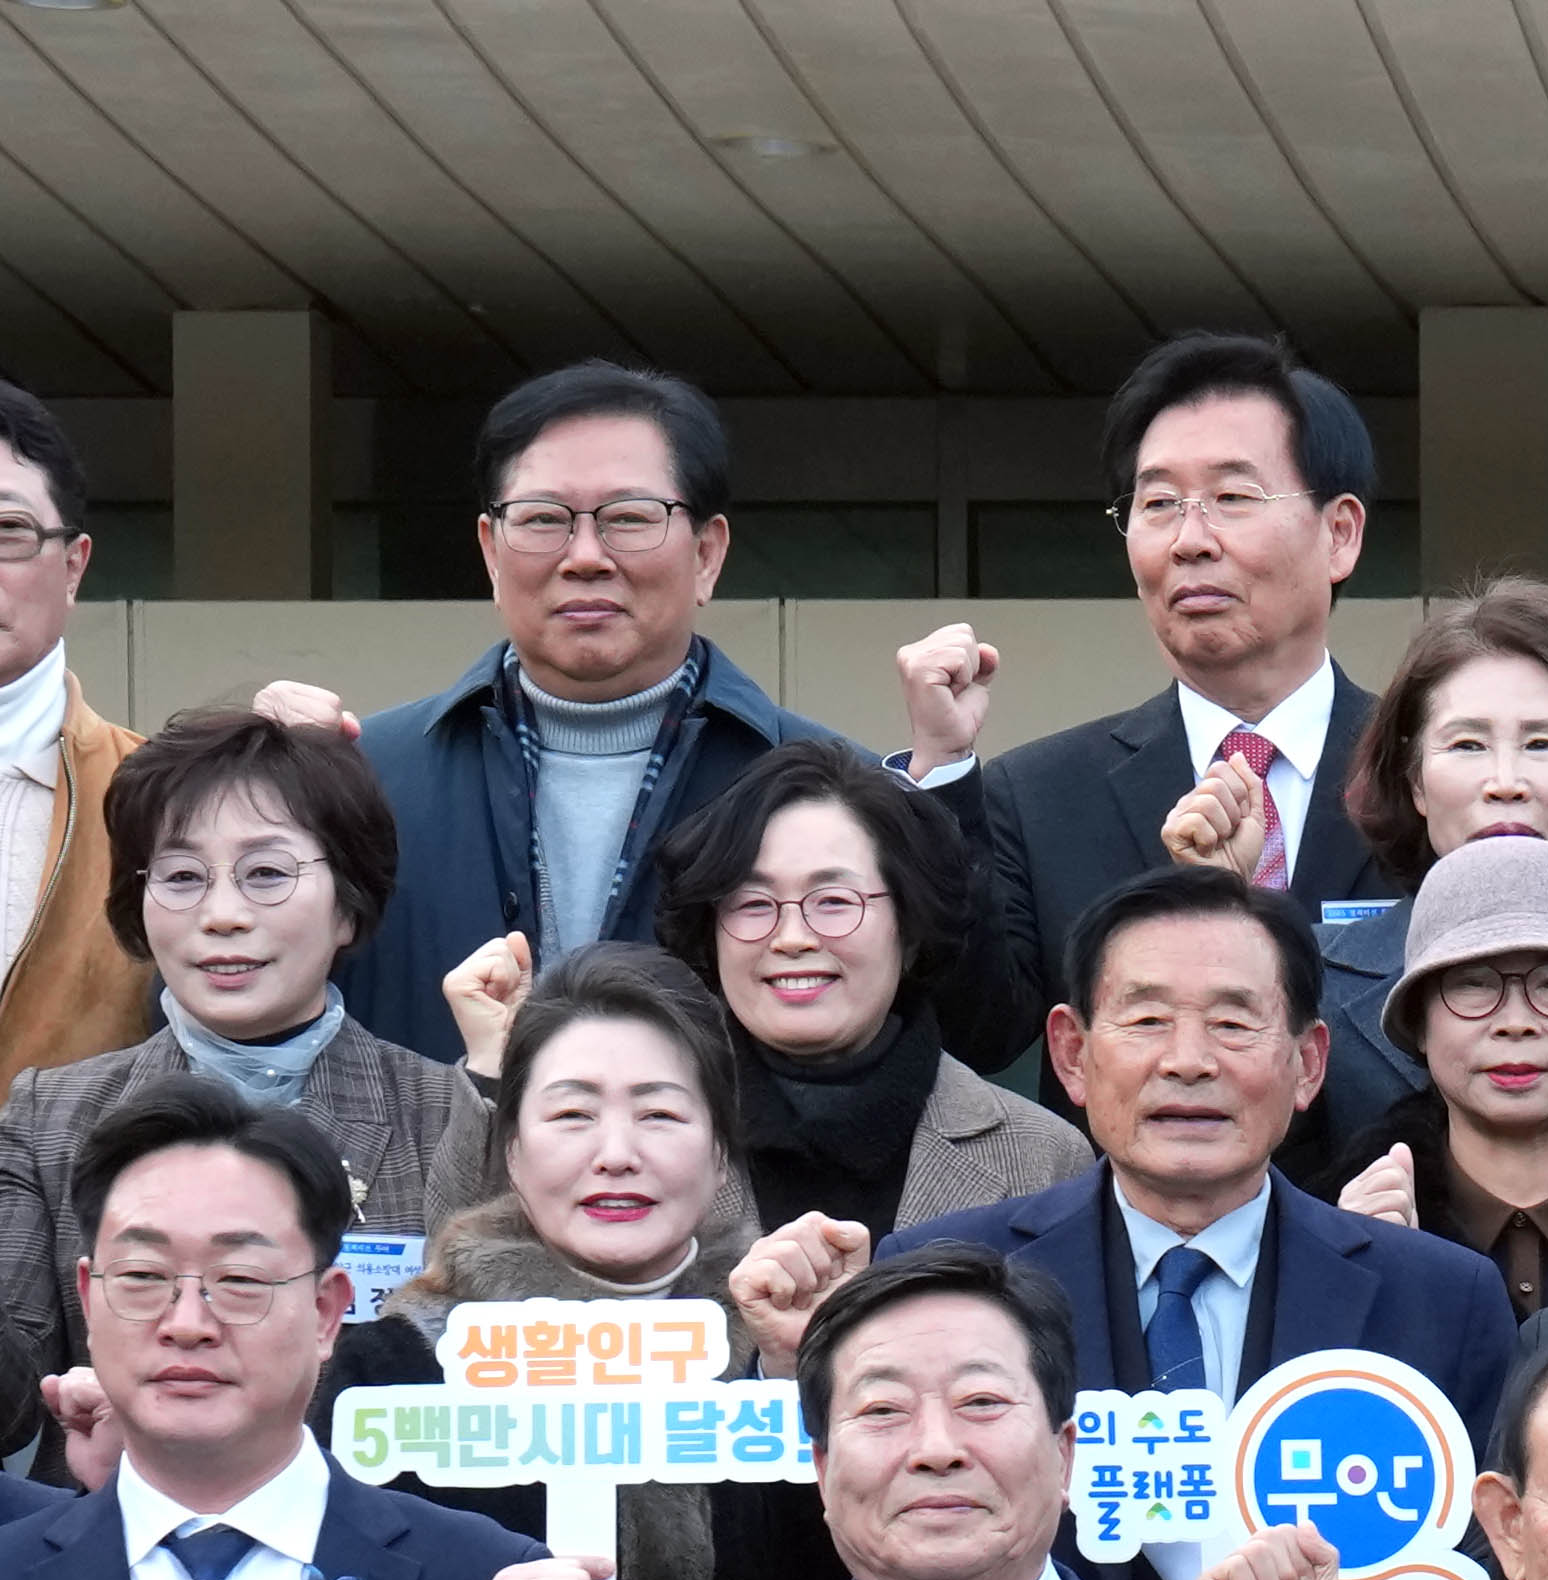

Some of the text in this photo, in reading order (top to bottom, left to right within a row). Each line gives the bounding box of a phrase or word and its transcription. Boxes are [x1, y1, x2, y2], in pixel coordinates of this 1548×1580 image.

[457, 1320, 709, 1388] 생활인구
[352, 1401, 642, 1469] 5백만시대
[1132, 1409, 1212, 1455] 수도
[1267, 1438, 1424, 1527] 무안
